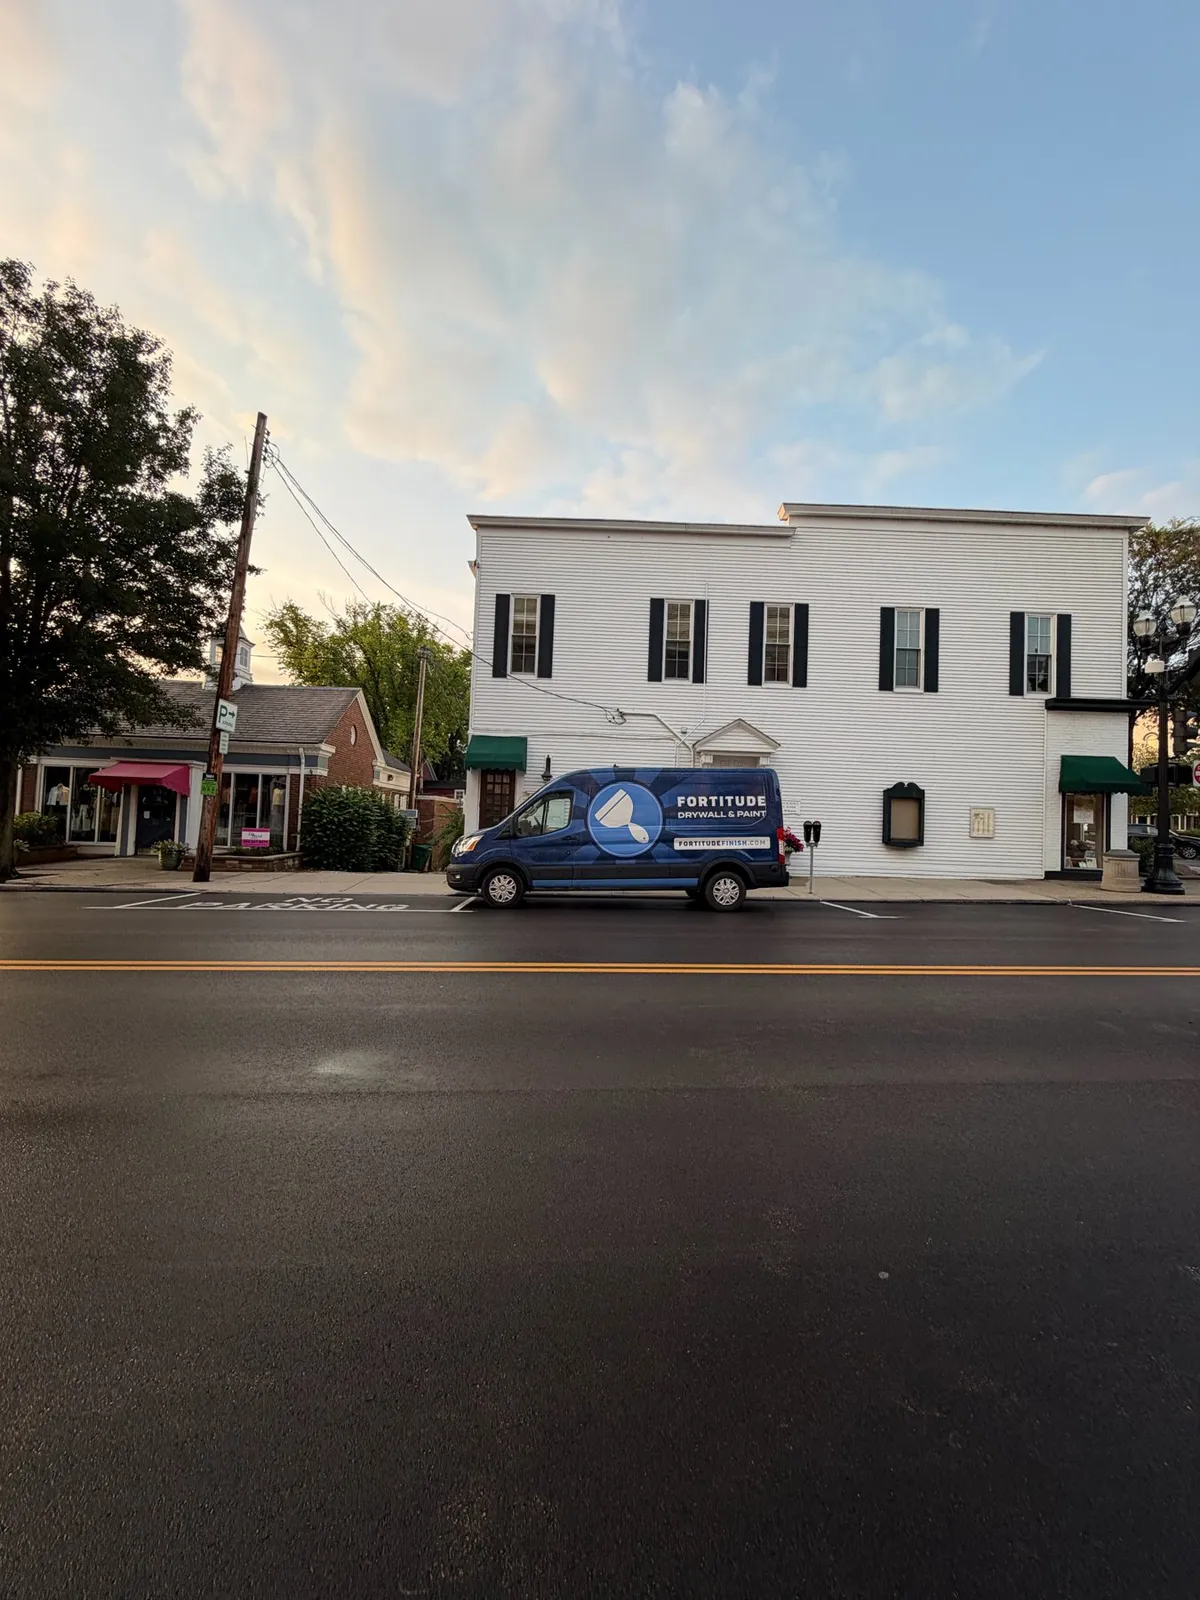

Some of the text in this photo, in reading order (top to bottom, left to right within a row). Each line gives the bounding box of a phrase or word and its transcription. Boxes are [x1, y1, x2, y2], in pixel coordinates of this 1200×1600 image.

[677, 795, 766, 807] FORTITUDE
[678, 811, 726, 819] DRYWALL
[737, 810, 767, 818] PAINT
[176, 901, 410, 910] PARKING
